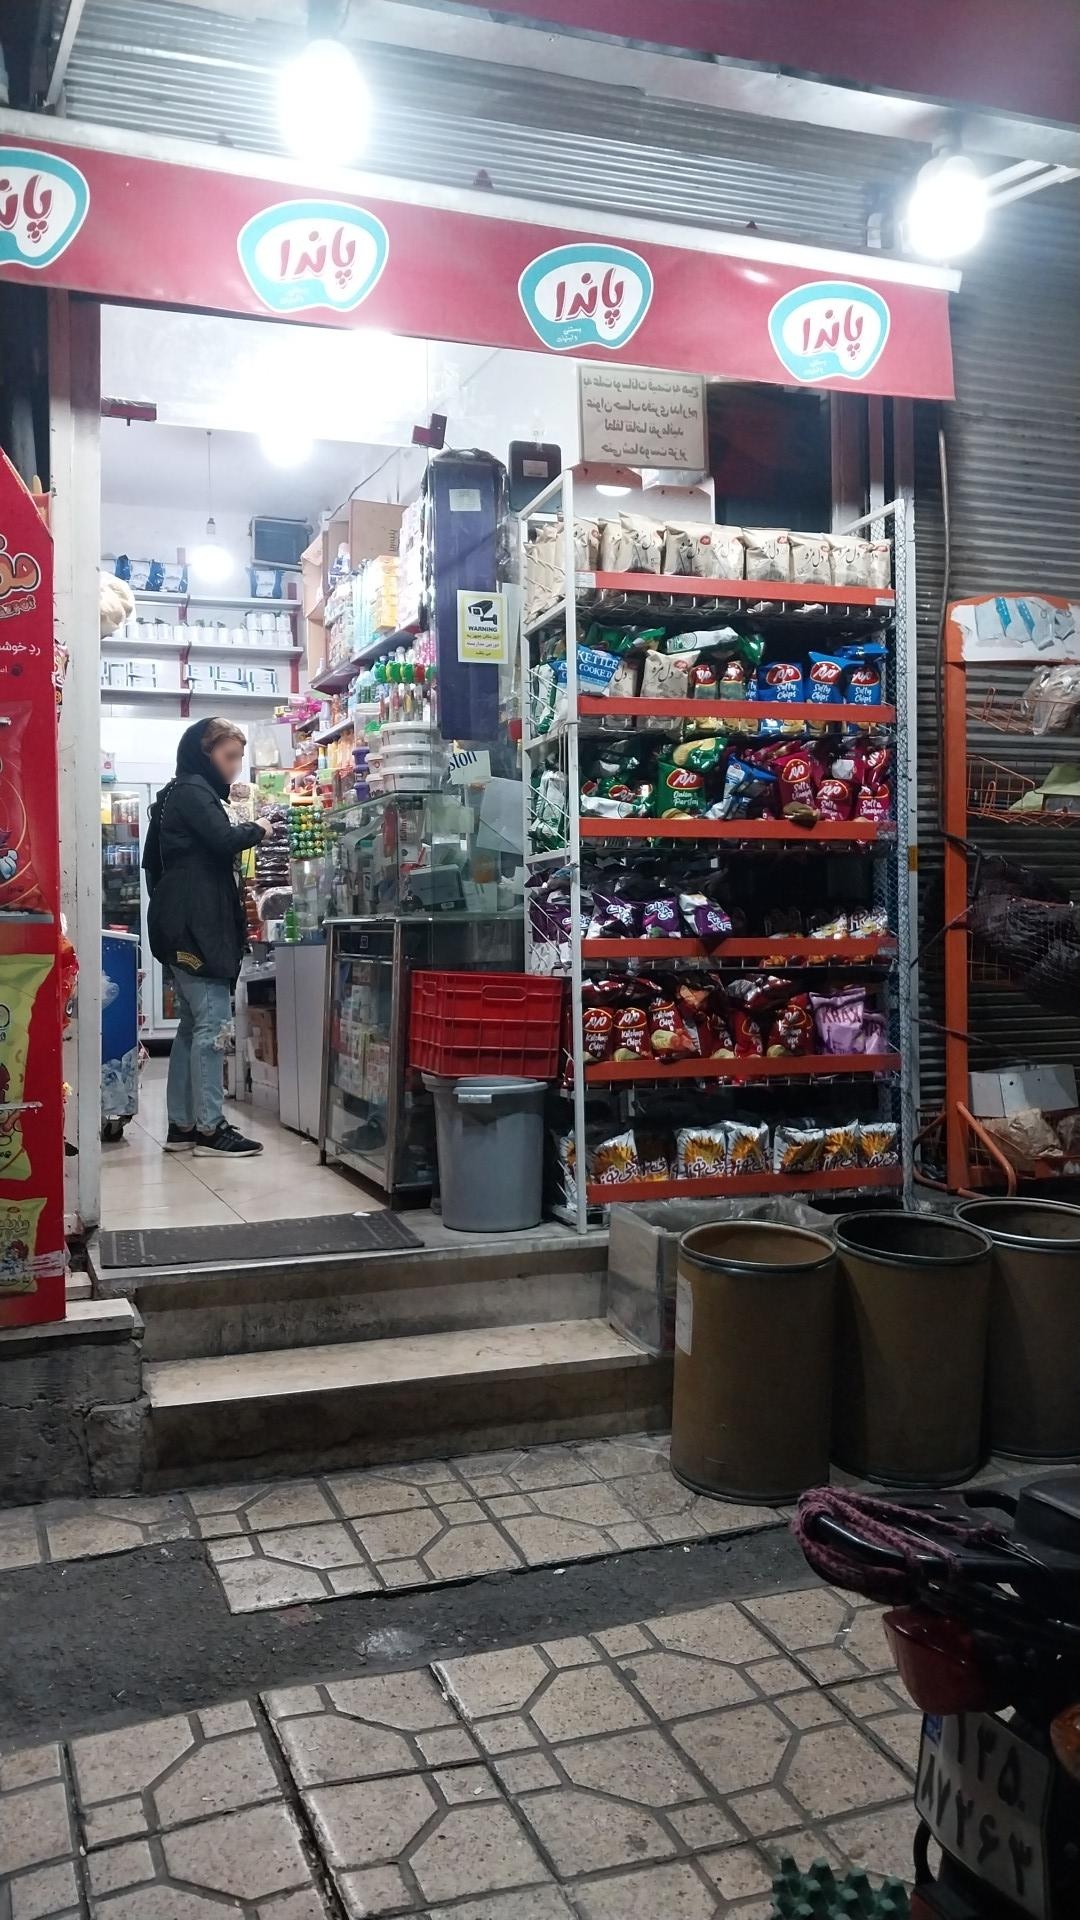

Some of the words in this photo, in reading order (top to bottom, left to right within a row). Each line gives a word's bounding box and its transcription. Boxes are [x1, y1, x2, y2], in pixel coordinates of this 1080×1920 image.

[280, 226, 357, 290] پاندا
[554, 267, 625, 329] پاندا
[802, 304, 864, 361] پاندا
[577, 649, 620, 671] KETTLE
[579, 663, 613, 679] COOKED
[776, 691, 797, 701] Chips
[811, 691, 830, 702] Chips
[855, 694, 872, 703] Chips
[821, 1006, 862, 1025] KRAX
